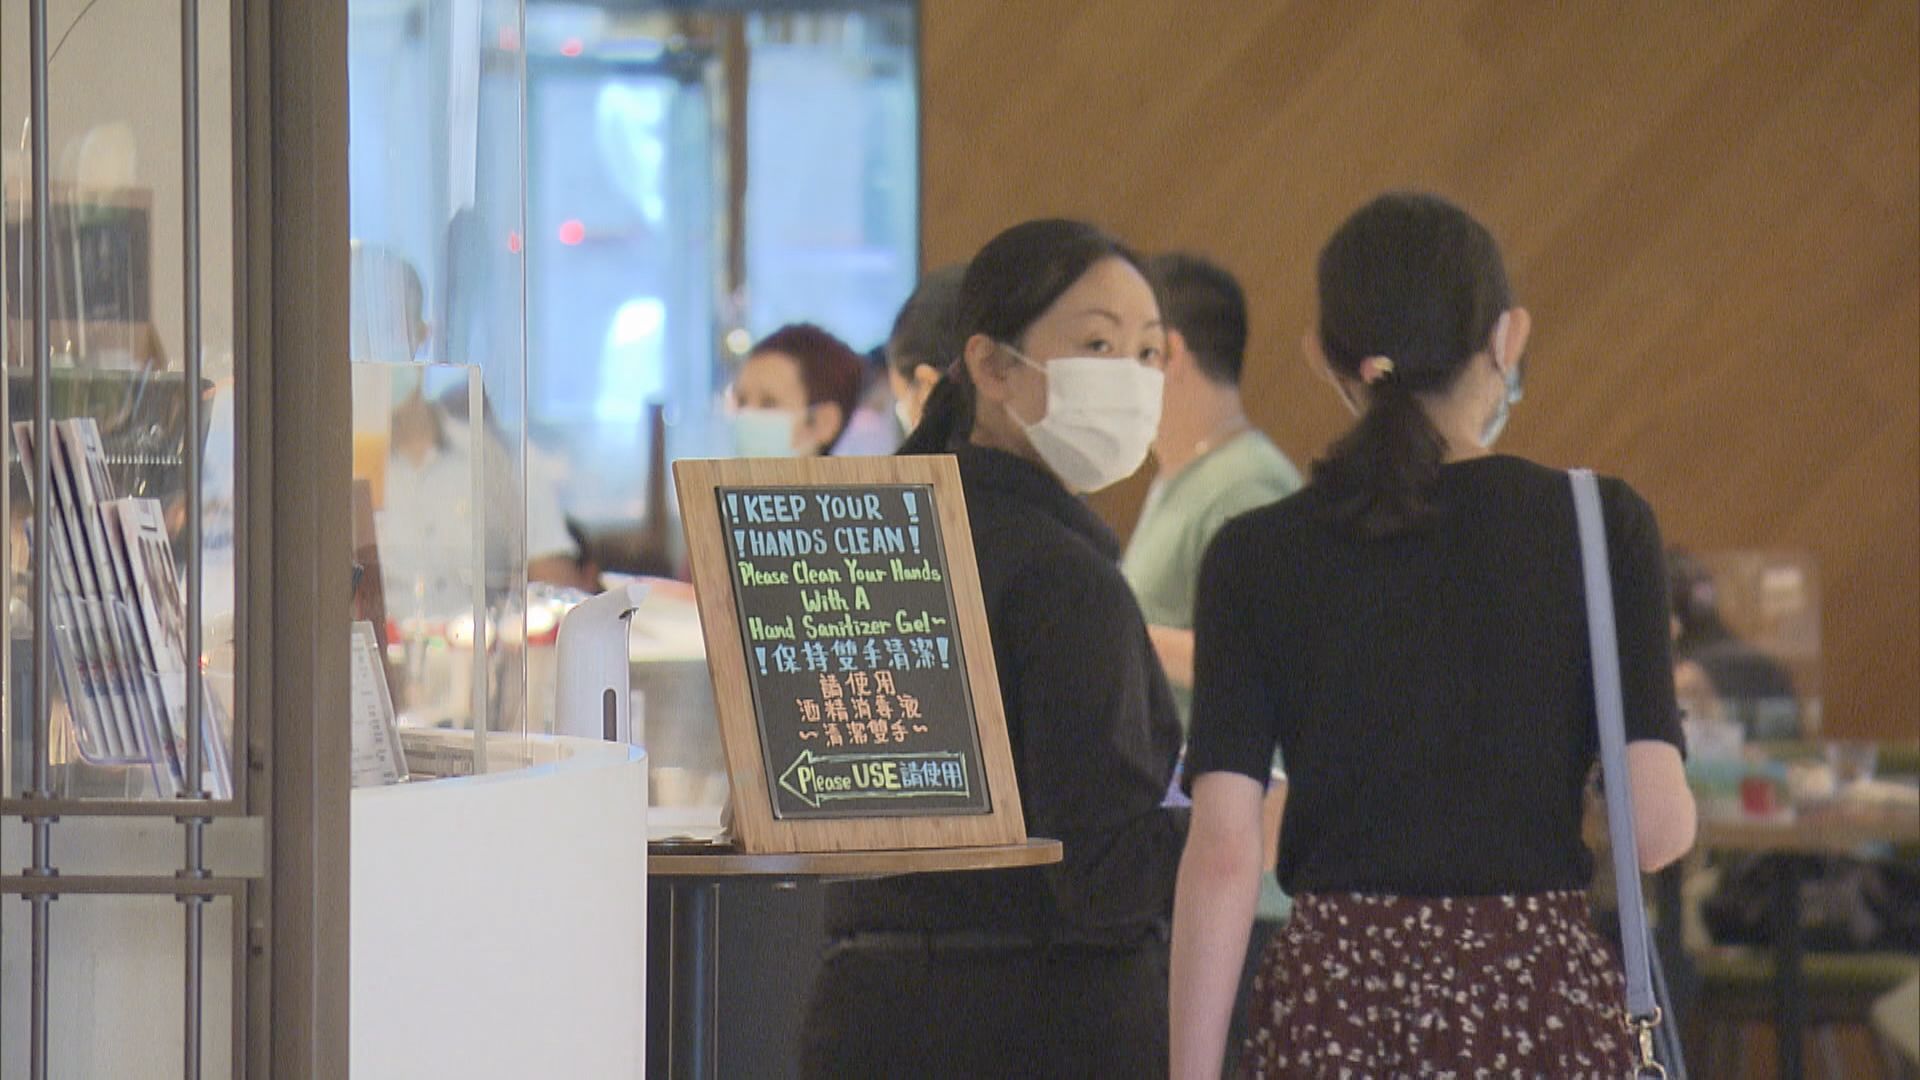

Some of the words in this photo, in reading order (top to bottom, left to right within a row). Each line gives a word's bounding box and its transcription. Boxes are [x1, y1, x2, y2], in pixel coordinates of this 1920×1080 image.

[816, 494, 883, 522] YOUR
[738, 560, 789, 586] Please
[792, 560, 841, 584] Clean
[844, 558, 887, 582] Your
[890, 558, 941, 582] Hands
[801, 588, 849, 613] With
[855, 586, 870, 611] A
[749, 616, 795, 640] Hand
[802, 614, 891, 639] Sanitizer
[819, 670, 896, 699] 請使用
[796, 694, 922, 722] 酒精消毒液
[797, 765, 850, 794] Please
[852, 762, 901, 790] USE
[901, 761, 963, 788] 請使用
